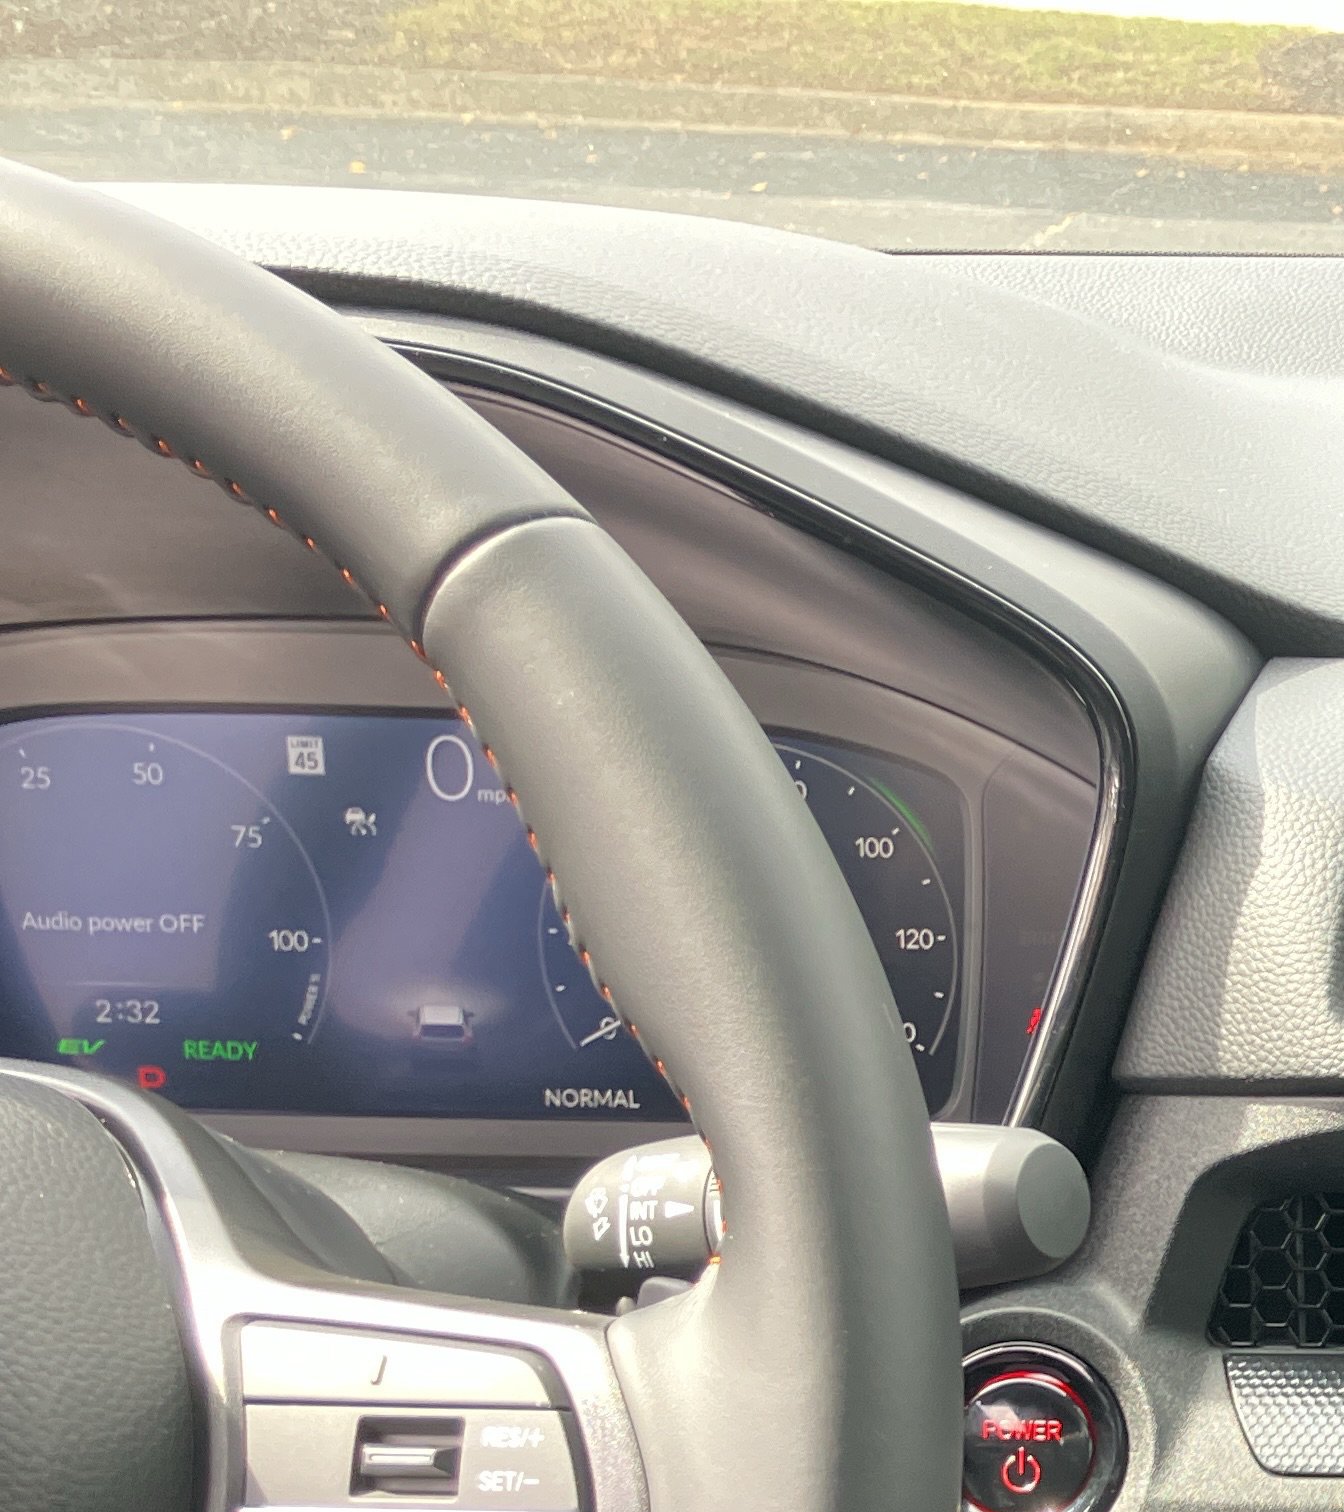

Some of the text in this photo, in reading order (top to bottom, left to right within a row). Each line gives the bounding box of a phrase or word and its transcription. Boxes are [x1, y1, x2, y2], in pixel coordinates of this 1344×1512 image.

[294, 751, 319, 770] 45
[427, 735, 474, 801] 0
[20, 765, 51, 789] 25
[132, 761, 163, 785] 50
[229, 824, 263, 848] 75
[855, 836, 894, 860] 100
[22, 910, 205, 935] Audio power OFF
[268, 928, 309, 952] 100
[895, 927, 935, 951] 120
[95, 999, 161, 1025] 2:32
[182, 1038, 258, 1060] READY
[543, 1087, 642, 1110] NORMAL
[629, 1200, 658, 1220] INT
[629, 1225, 653, 1247] LO
[633, 1250, 656, 1269] HI
[982, 1419, 1062, 1441] POWER
